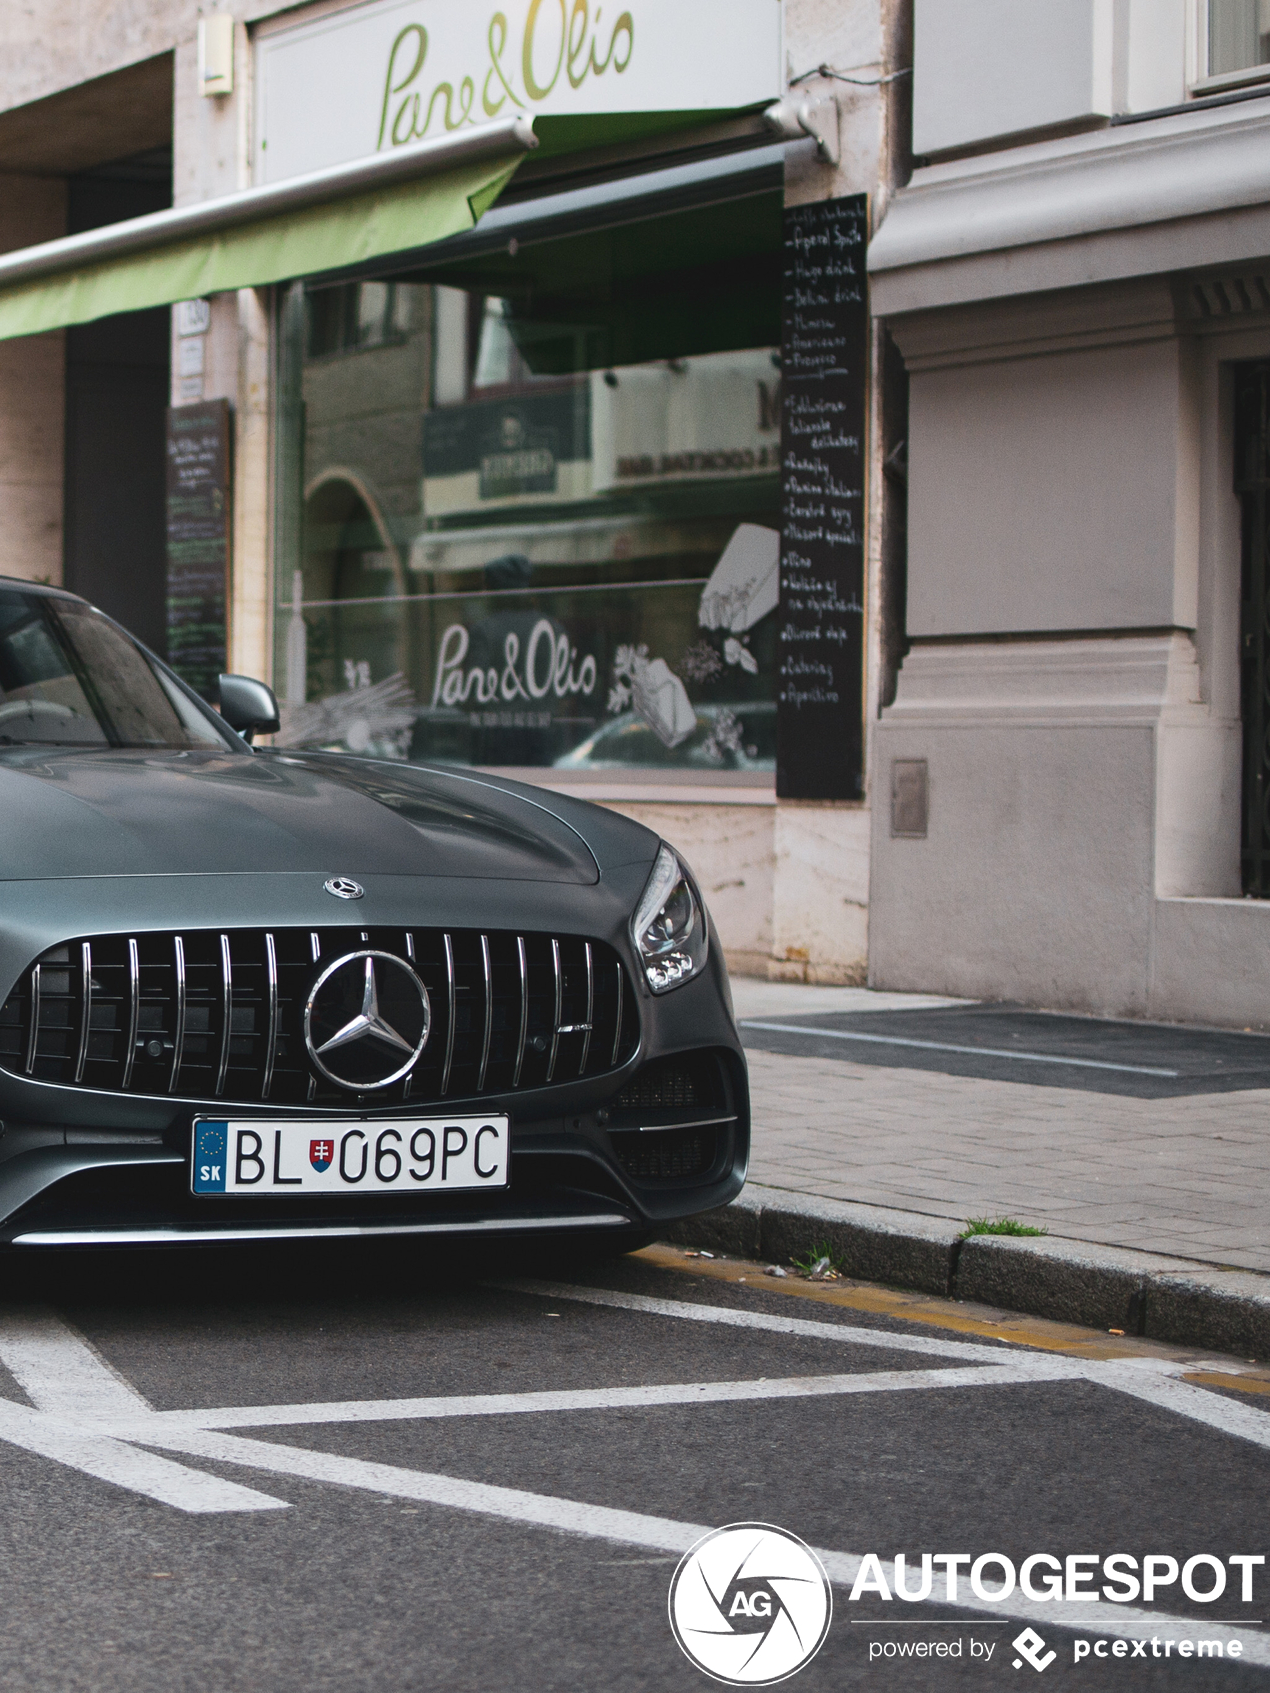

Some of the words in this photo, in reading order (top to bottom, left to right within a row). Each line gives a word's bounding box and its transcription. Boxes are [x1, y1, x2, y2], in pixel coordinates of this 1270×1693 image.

[200, 1165, 221, 1181] SK
[235, 1129, 303, 1185] BL
[339, 1124, 499, 1184] 069PC
